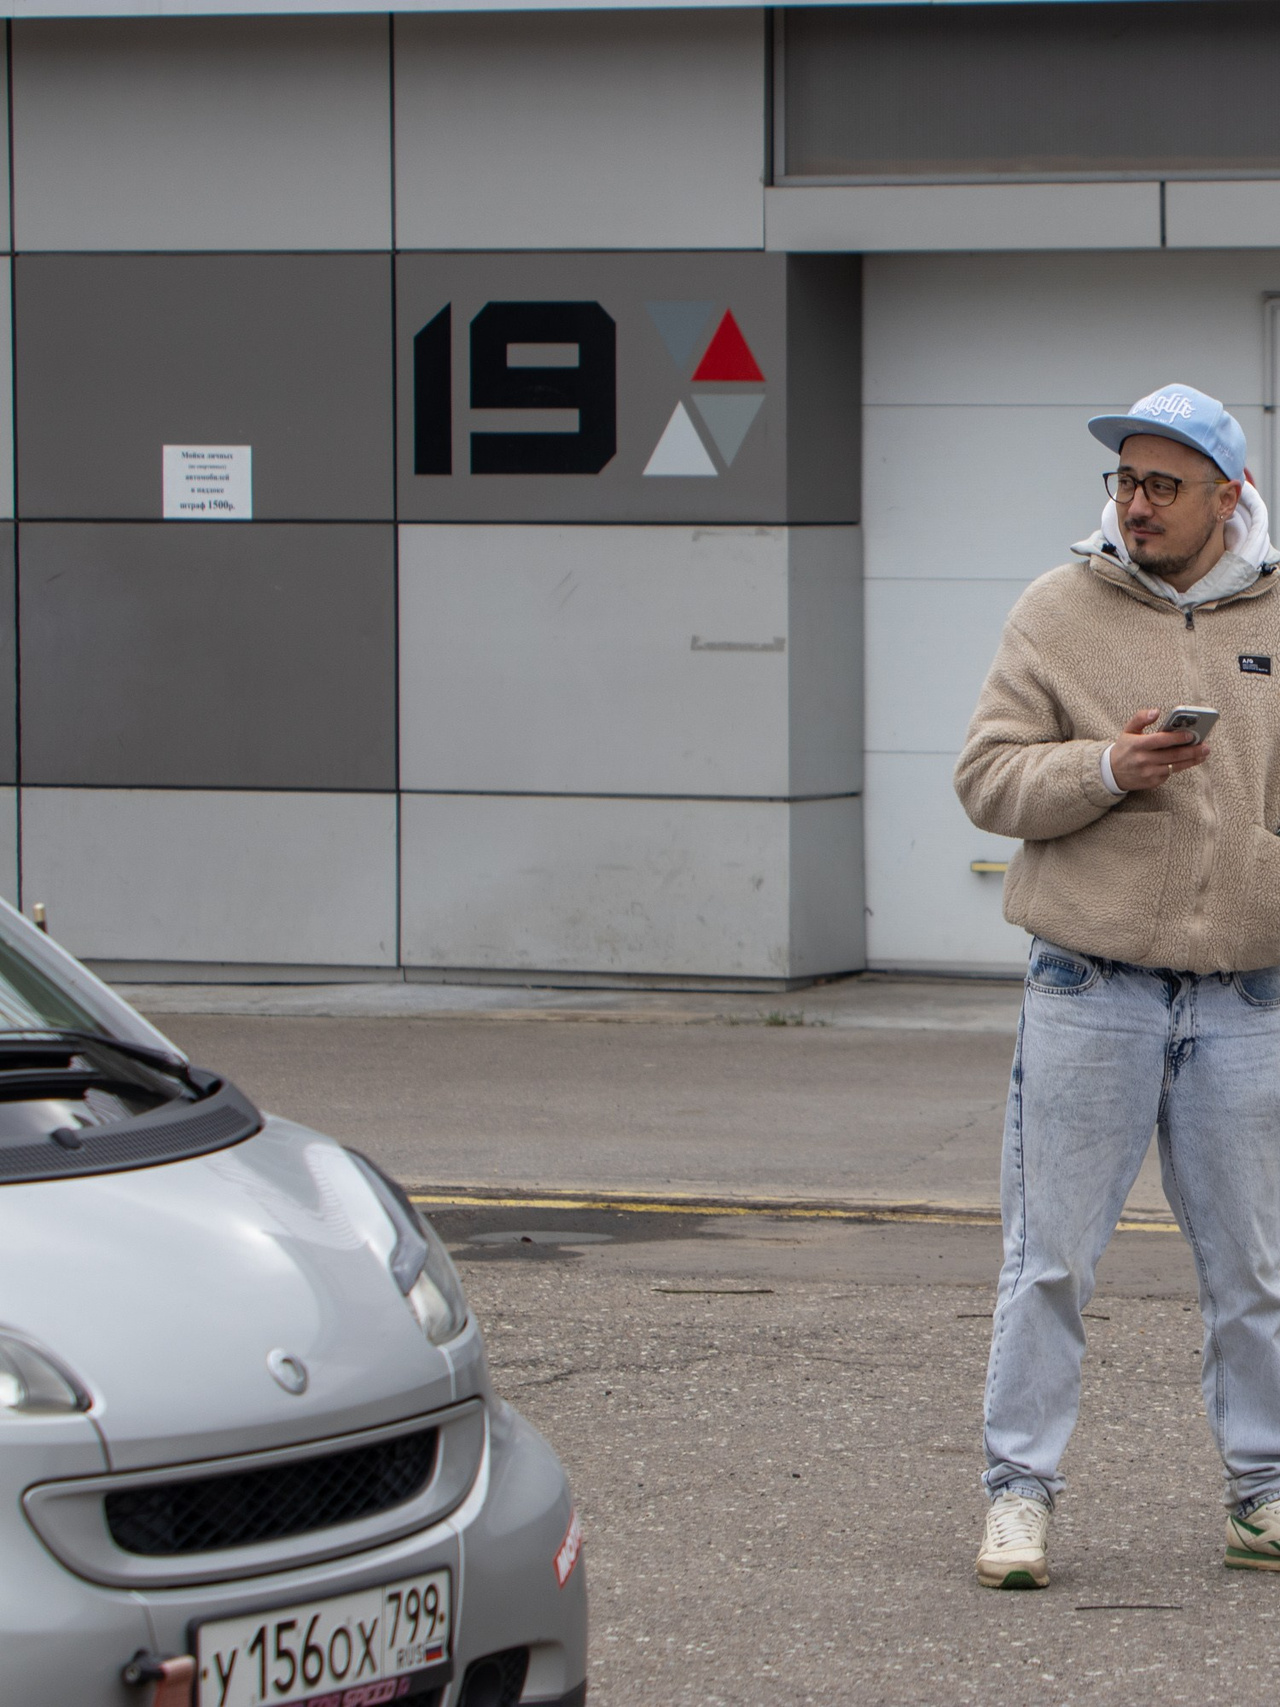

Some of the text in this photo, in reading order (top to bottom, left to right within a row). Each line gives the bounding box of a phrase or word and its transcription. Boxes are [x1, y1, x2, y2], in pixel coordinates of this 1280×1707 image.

[414, 300, 617, 476] 19
[181, 451, 205, 460] Мойка
[180, 502, 206, 512] штраф
[386, 1583, 440, 1650] 799
